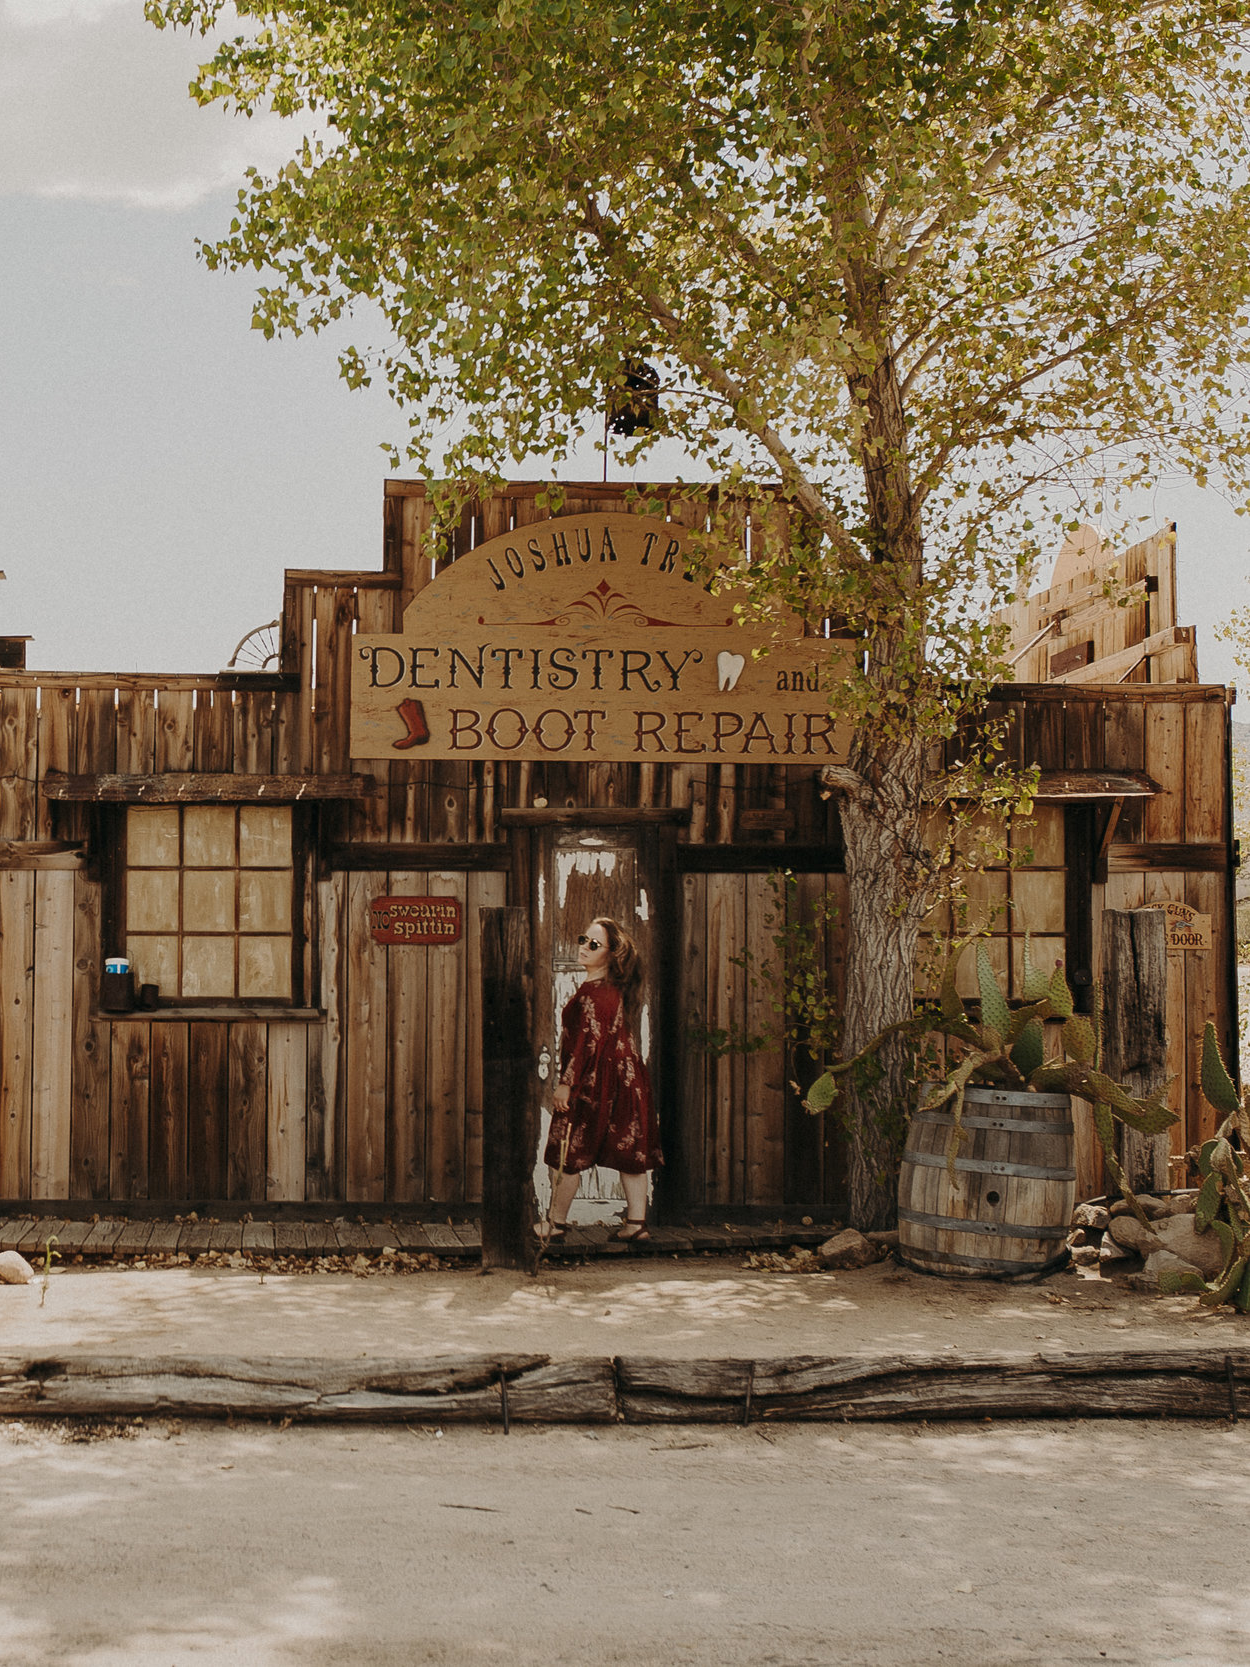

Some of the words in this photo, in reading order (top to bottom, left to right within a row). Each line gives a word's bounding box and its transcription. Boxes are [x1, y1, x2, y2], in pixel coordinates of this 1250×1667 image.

[485, 526, 617, 592] JOSHUA
[639, 531, 730, 597] TR
[358, 643, 704, 692] DENTISTRY
[776, 663, 820, 692] and
[447, 708, 607, 752] BOOT
[632, 710, 840, 756] REPAIR
[372, 911, 390, 930] NO
[390, 904, 456, 918] swearin
[393, 919, 455, 939] spittin
[1170, 933, 1204, 946] DOOR
